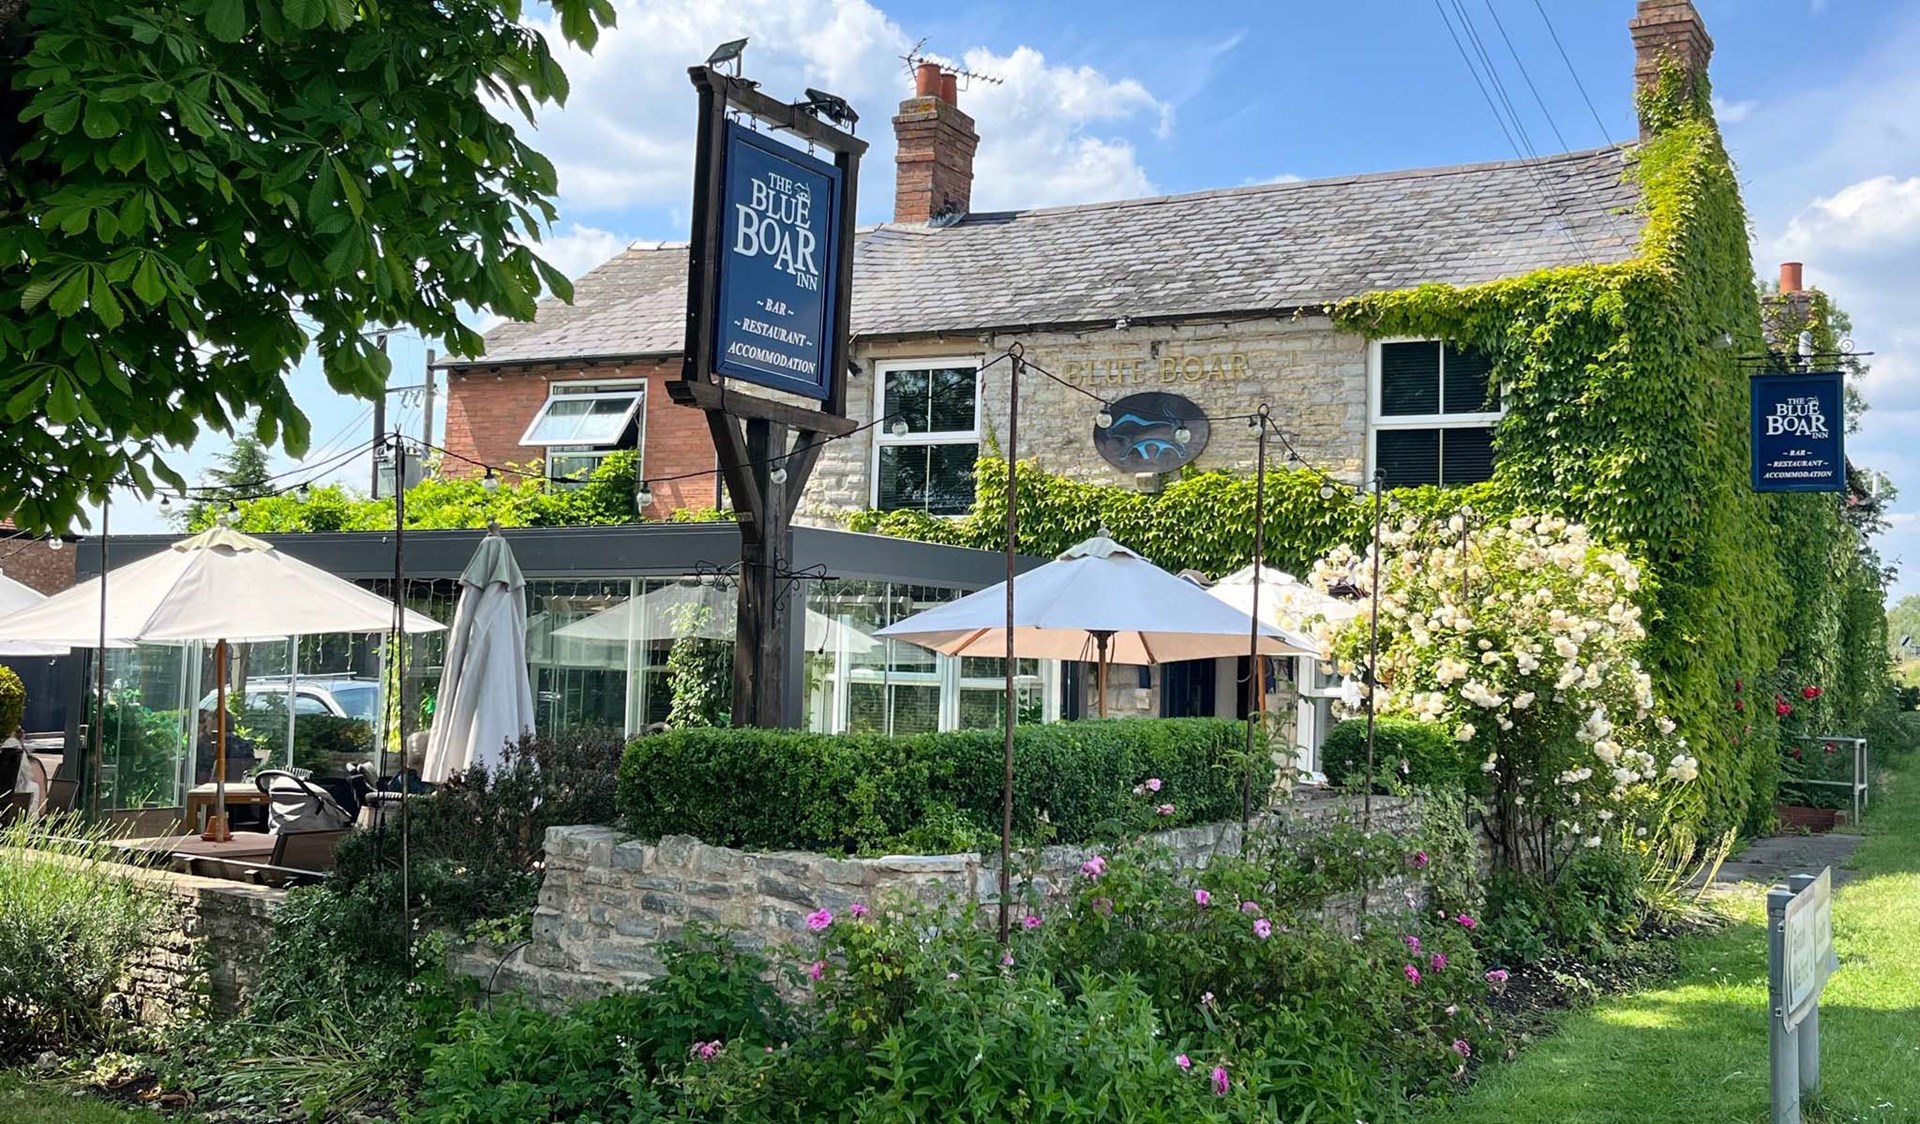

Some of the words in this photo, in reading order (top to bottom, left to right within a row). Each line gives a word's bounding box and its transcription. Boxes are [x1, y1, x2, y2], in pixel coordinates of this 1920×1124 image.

[768, 172, 793, 195] THE
[749, 178, 811, 227] BLUE
[733, 203, 819, 276] BOAR
[796, 272, 818, 292] INN
[764, 298, 787, 316] BAR
[743, 317, 807, 347] RESTAURANT
[728, 341, 816, 374] ACCOMMODATION
[1066, 359, 1147, 386] BLUE
[1160, 353, 1250, 384] BOAR
[1775, 402, 1820, 416] BLUE
[1765, 415, 1829, 436] BOAR
[1773, 460, 1823, 468] RESTAURANT
